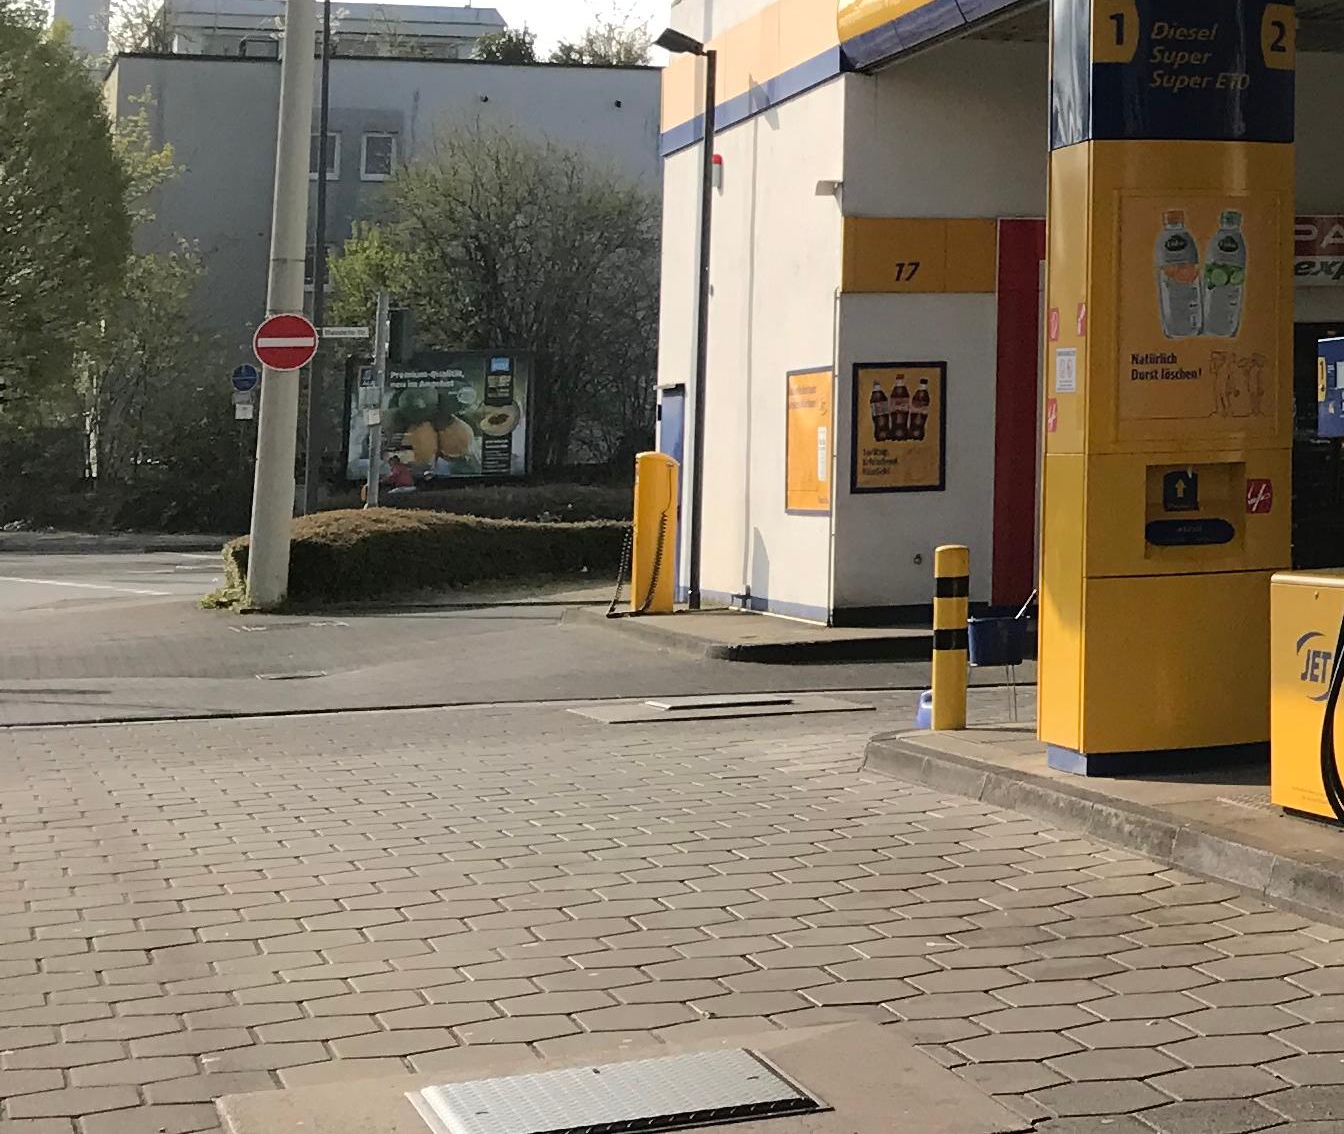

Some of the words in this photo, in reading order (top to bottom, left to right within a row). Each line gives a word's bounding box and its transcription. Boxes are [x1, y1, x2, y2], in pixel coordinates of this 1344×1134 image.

[1110, 13, 1124, 46] 1
[1151, 22, 1219, 41] Diesel
[1270, 21, 1287, 53] 2
[1150, 46, 1212, 70] Super
[1150, 70, 1212, 93] Super
[1216, 72, 1250, 91] E10
[896, 262, 920, 282] 17
[1131, 352, 1177, 365] Natürlich
[1131, 368, 1158, 380] Durst
[1161, 367, 1202, 380] löschen!
[1300, 650, 1332, 684] JET
